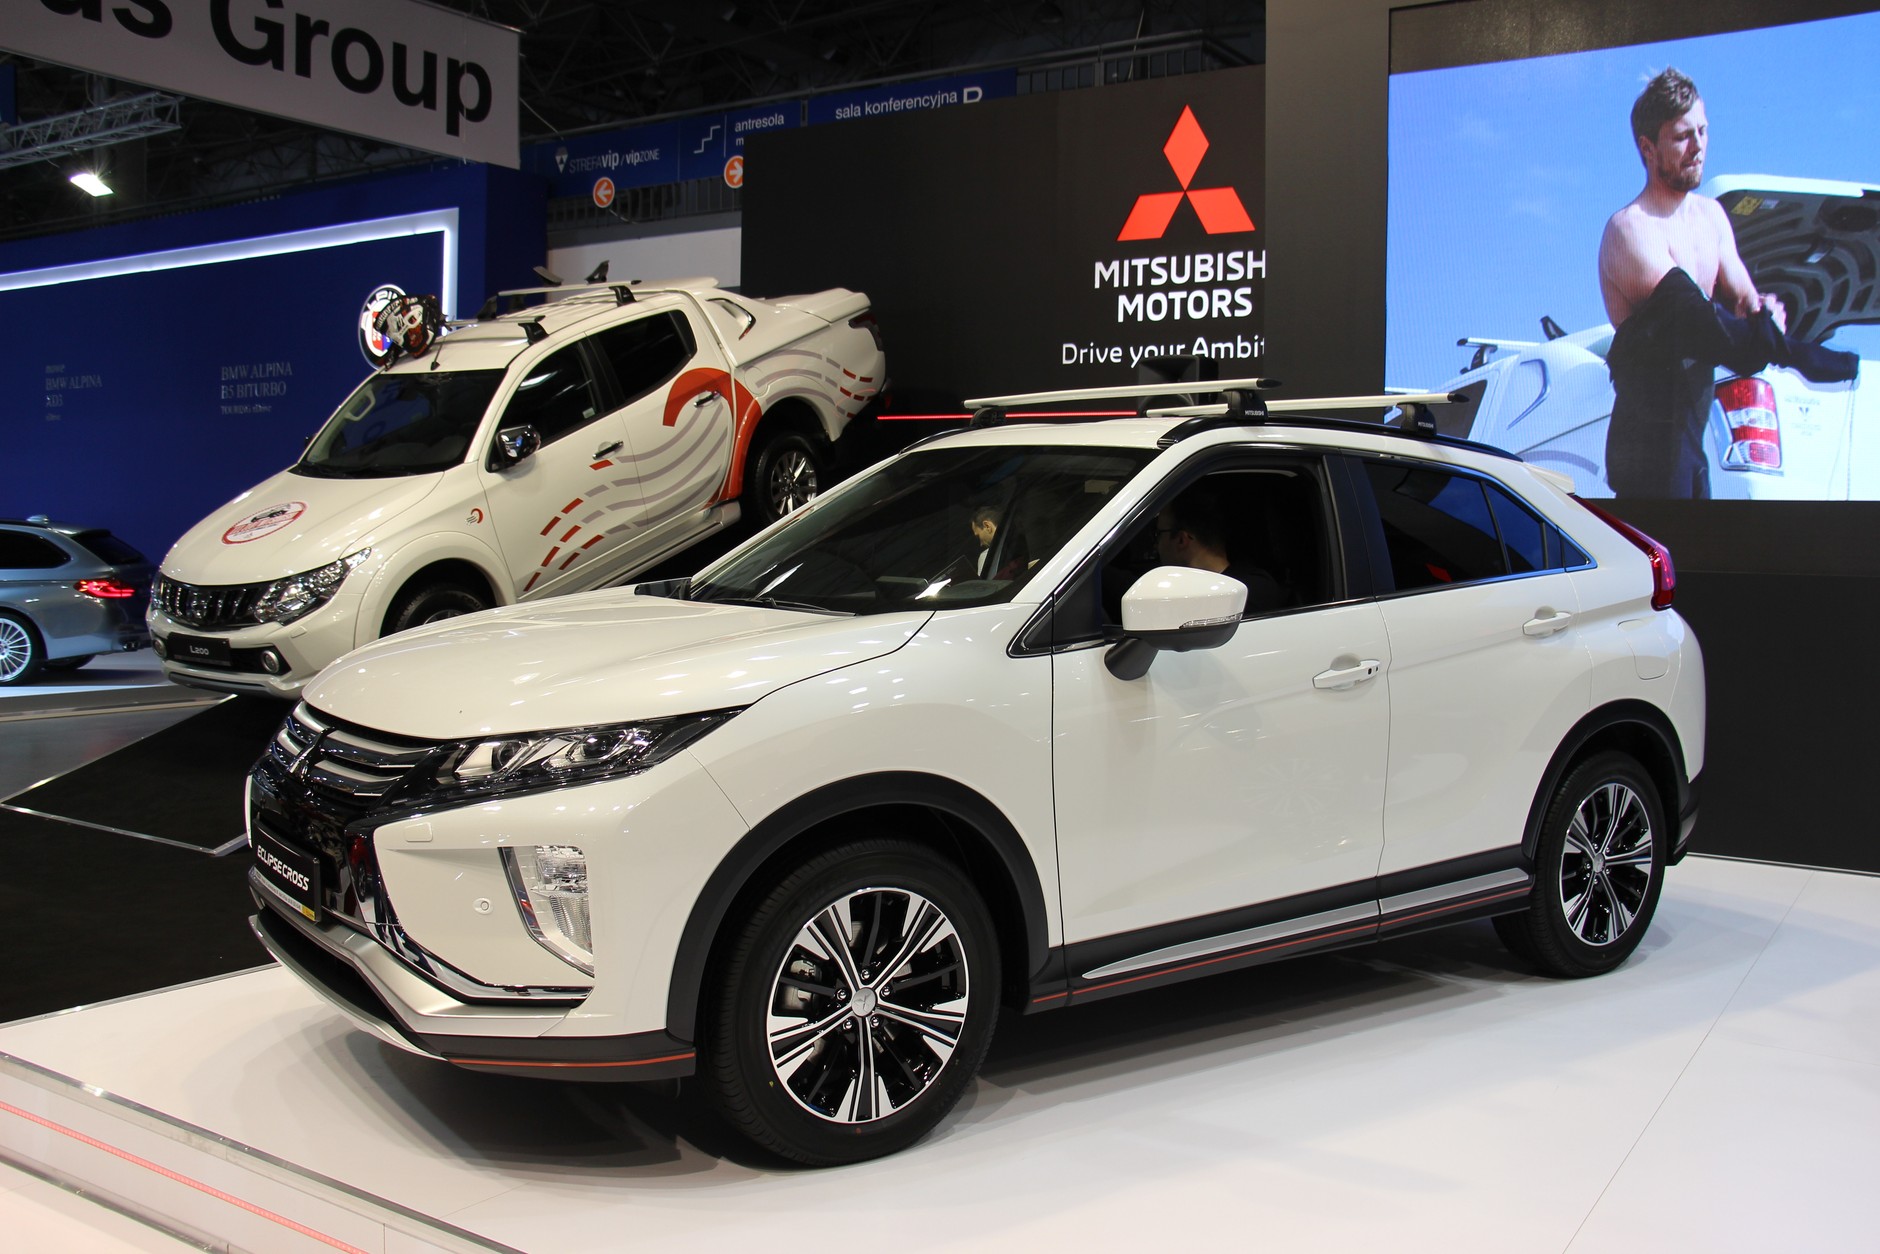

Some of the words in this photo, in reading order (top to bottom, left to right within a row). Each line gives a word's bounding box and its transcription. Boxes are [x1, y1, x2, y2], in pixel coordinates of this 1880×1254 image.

[210, 0, 492, 137] Group
[835, 103, 861, 120] sala
[865, 90, 958, 116] konferencyjna
[963, 86, 983, 104] D
[734, 112, 785, 133] antresola
[1117, 287, 1253, 323] MOTORS
[1062, 342, 1123, 365] Drive
[1129, 343, 1186, 369] your
[68, 373, 103, 390] ALPINA
[221, 364, 249, 381] BMW
[250, 361, 293, 379] ALPINA
[221, 384, 235, 400] B5
[236, 380, 287, 399] BITURBO
[257, 844, 283, 875] ECLIPSE
[282, 863, 310, 891] CROSS
